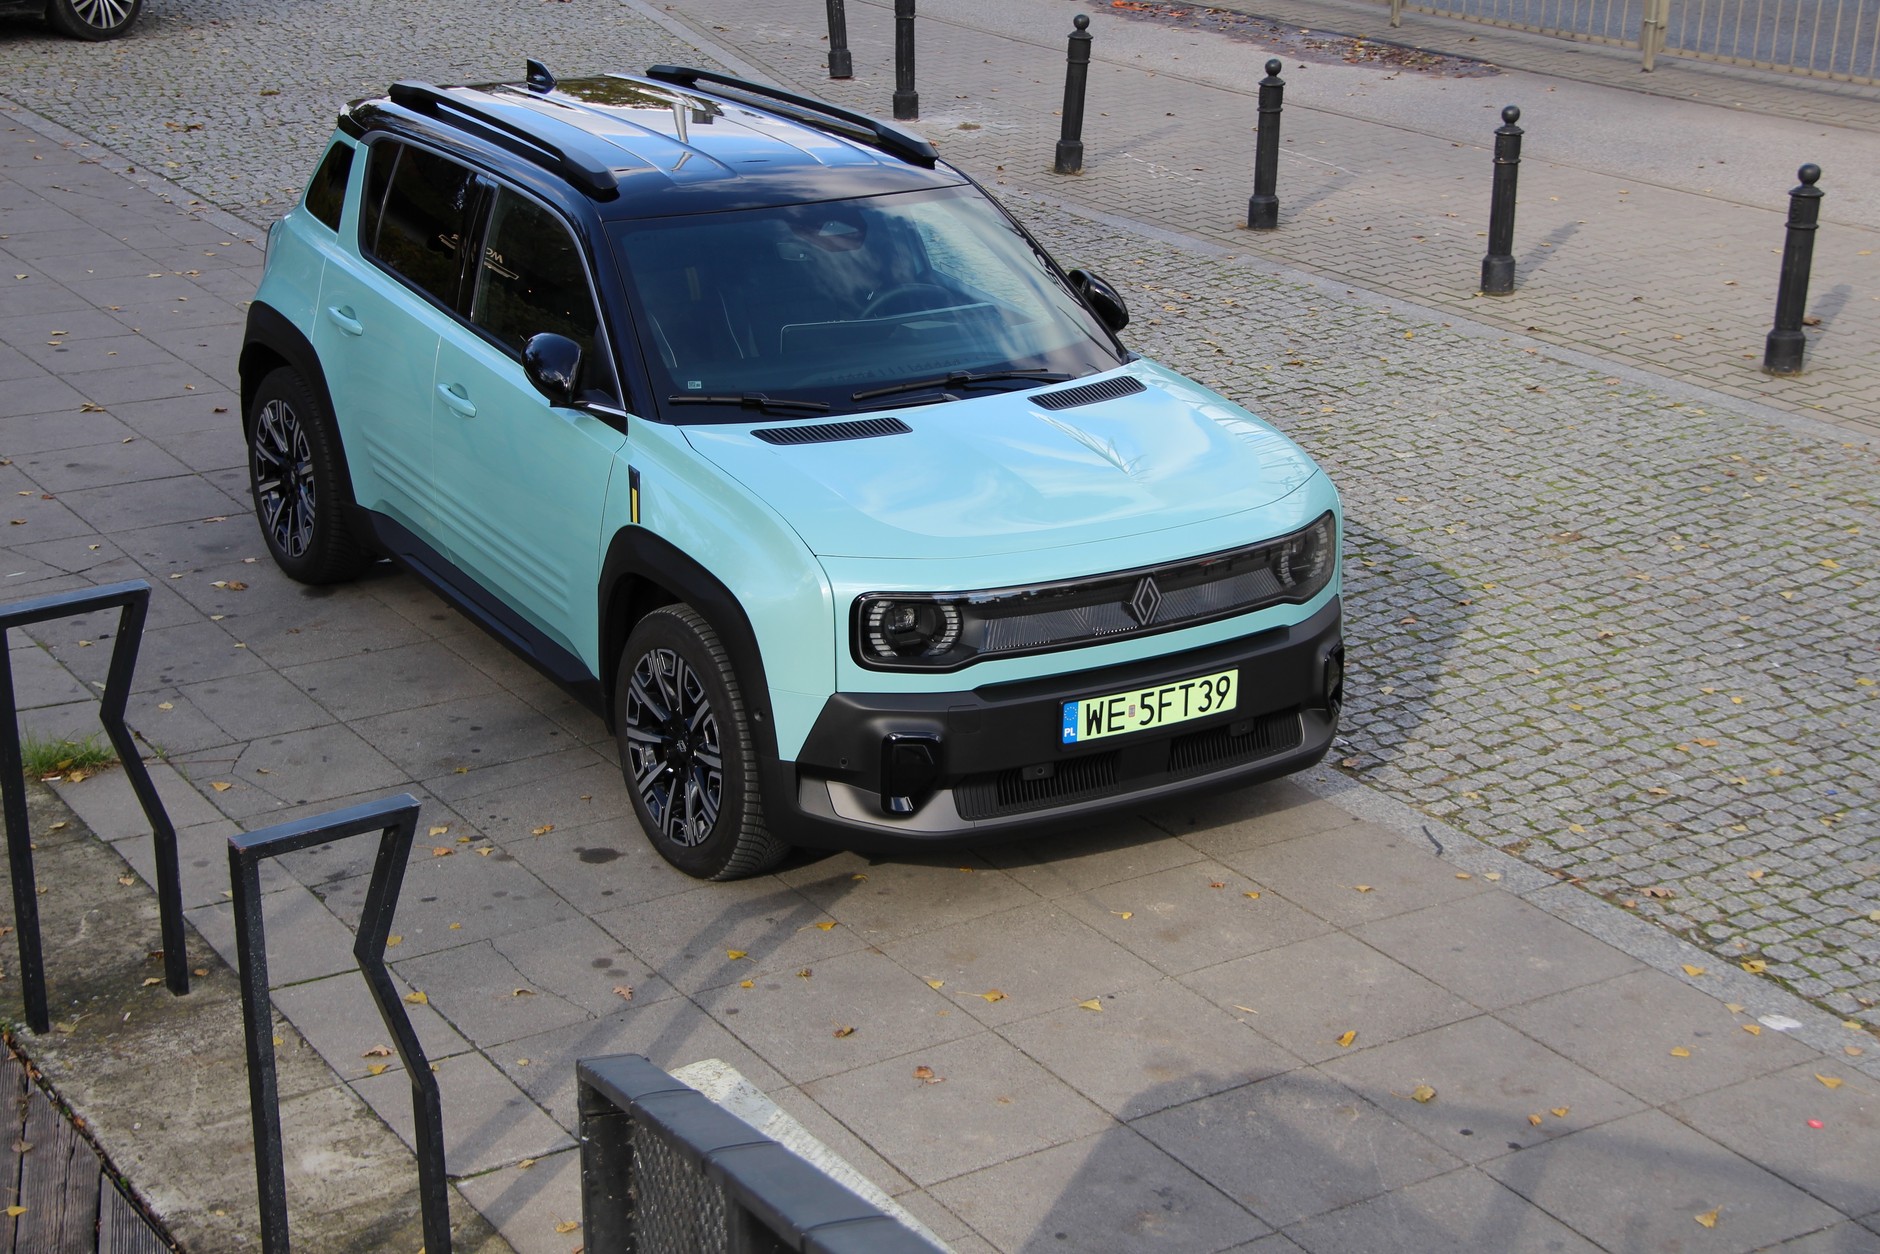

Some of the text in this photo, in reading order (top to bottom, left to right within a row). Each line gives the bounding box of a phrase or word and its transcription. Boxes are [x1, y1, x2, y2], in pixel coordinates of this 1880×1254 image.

[1086, 675, 1231, 736] WE 5FT39
[1064, 727, 1076, 737] PL
